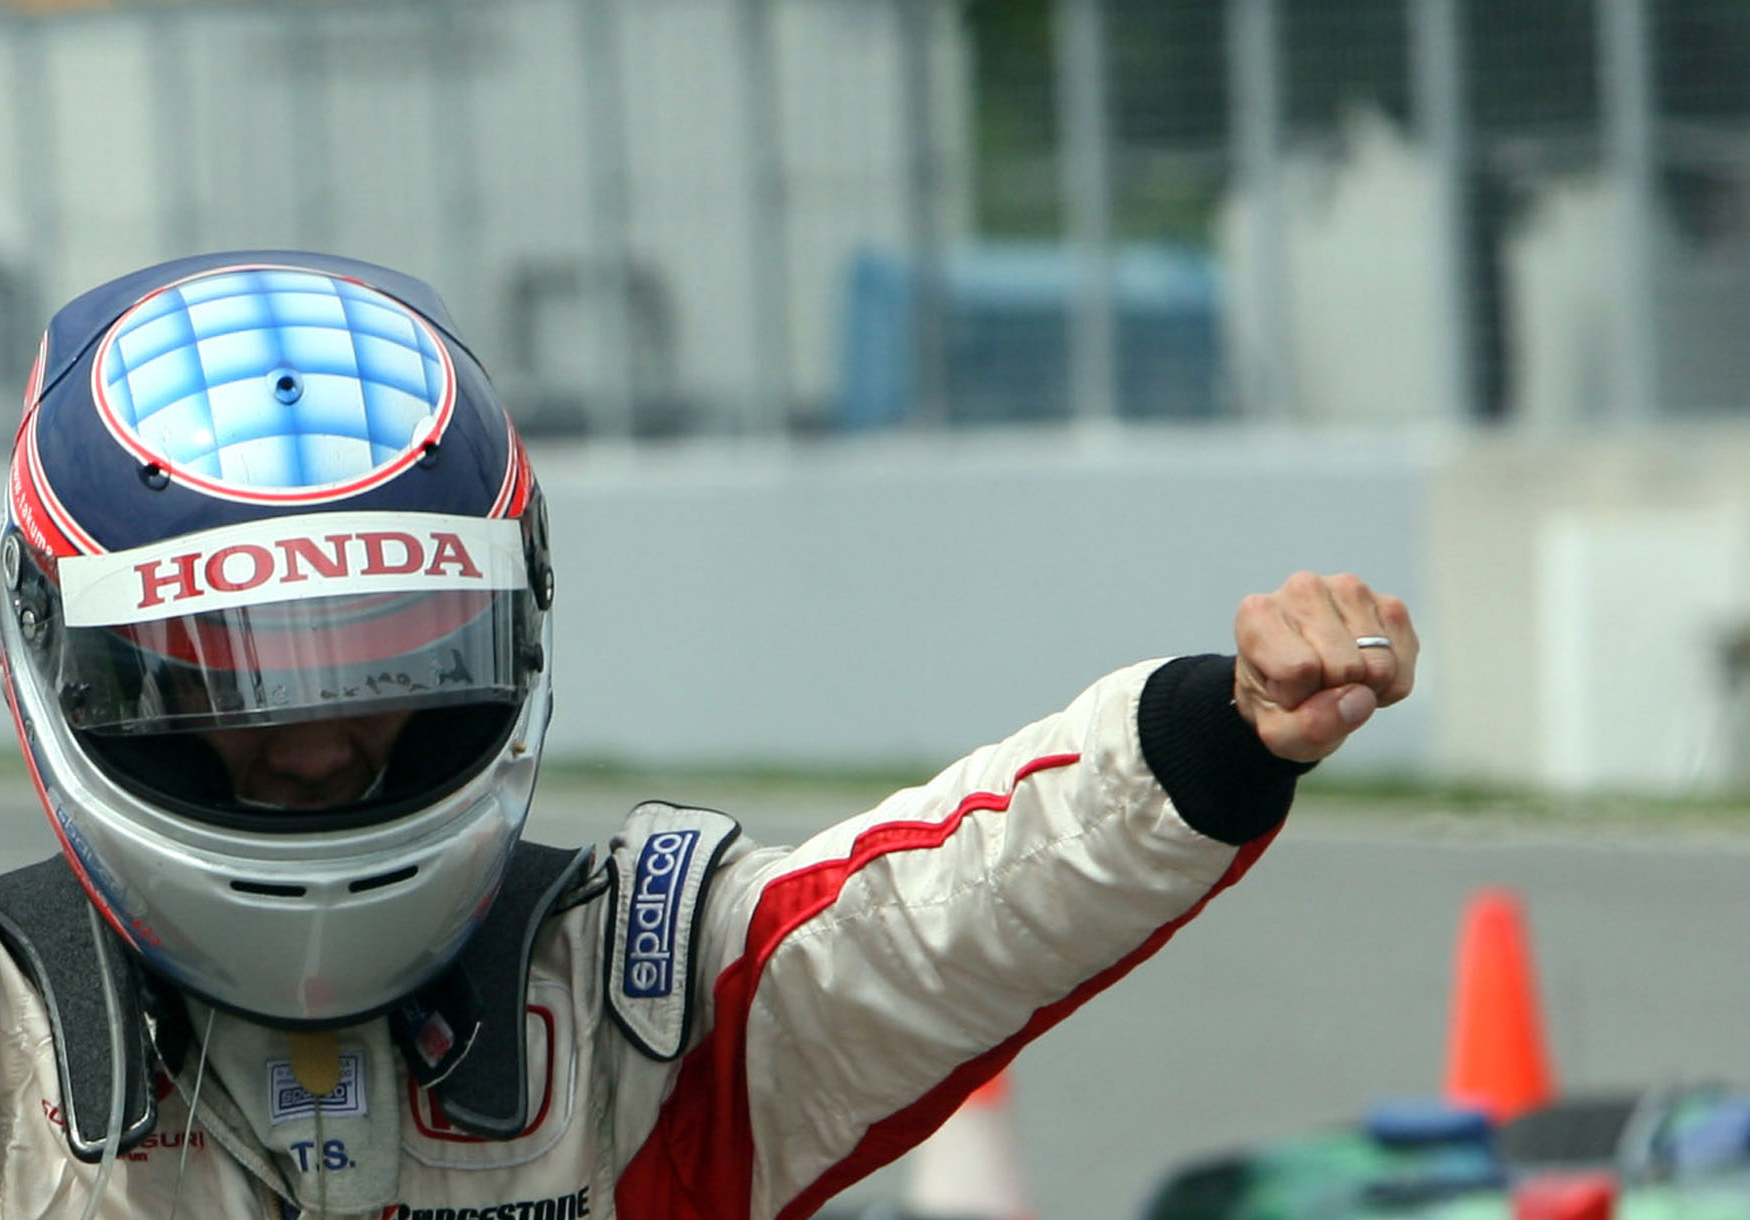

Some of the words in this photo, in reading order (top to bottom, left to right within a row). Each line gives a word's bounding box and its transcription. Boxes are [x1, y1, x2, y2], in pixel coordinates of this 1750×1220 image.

[134, 531, 483, 609] HONDA
[630, 833, 684, 991] sparco
[290, 1139, 357, 1173] T.S.
